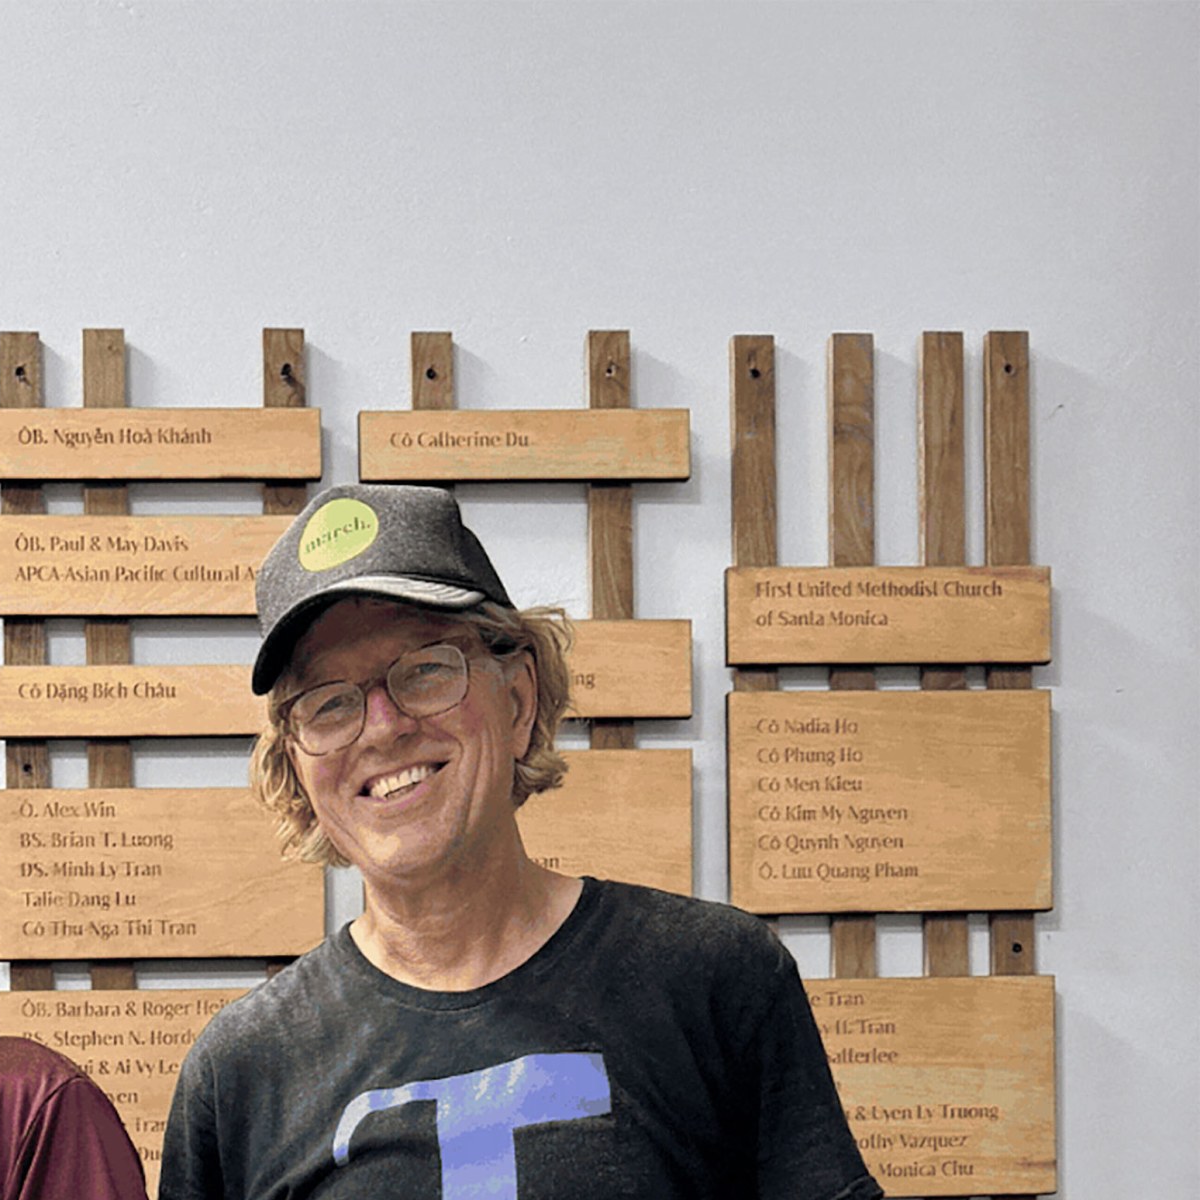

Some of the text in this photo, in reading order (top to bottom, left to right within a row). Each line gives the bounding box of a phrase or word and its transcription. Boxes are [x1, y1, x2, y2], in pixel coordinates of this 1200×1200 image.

[417, 431, 501, 448] Catherine
[506, 432, 529, 447] Du
[50, 535, 85, 552] Paul
[90, 536, 101, 551] &
[107, 536, 138, 556] May
[144, 535, 189, 552] Davis
[115, 565, 167, 582] Pacific
[173, 565, 239, 582] Cultural
[755, 580, 1003, 598] First United Methodist Church
[756, 609, 888, 627] of Santa Monica
[784, 718, 830, 734] Nadia
[835, 718, 858, 734] Ho
[784, 747, 835, 767] Phung
[840, 747, 863, 763] Ho
[784, 777, 820, 792] Men
[825, 776, 862, 791] Kieu
[43, 801, 79, 818] Alex
[83, 801, 116, 818] Win
[786, 804, 816, 821] Kim
[822, 805, 843, 824] My
[20, 831, 174, 850] BS. Brian T. Luong
[52, 861, 95, 877] Minh
[100, 862, 118, 880] Ly
[121, 862, 162, 877] Tran
[817, 863, 870, 882] Quang
[875, 862, 919, 878] Pham
[50, 920, 83, 937] Thu
[124, 918, 152, 936] Thi
[156, 919, 197, 936] Tran
[825, 991, 865, 1006] Tran
[56, 1001, 120, 1017] Barbara
[125, 1001, 137, 1017] &
[143, 1001, 193, 1020] Roger
[857, 1019, 895, 1034] Tran
[54, 1030, 124, 1051] Stephen
[151, 1028, 196, 1046] Hord
[828, 1047, 898, 1064] atterlee
[99, 1060, 110, 1075] &
[855, 1105, 866, 1121] &
[938, 1104, 999, 1121] Truong
[855, 1134, 895, 1150] othy
[879, 1160, 974, 1177] Monica Chu
